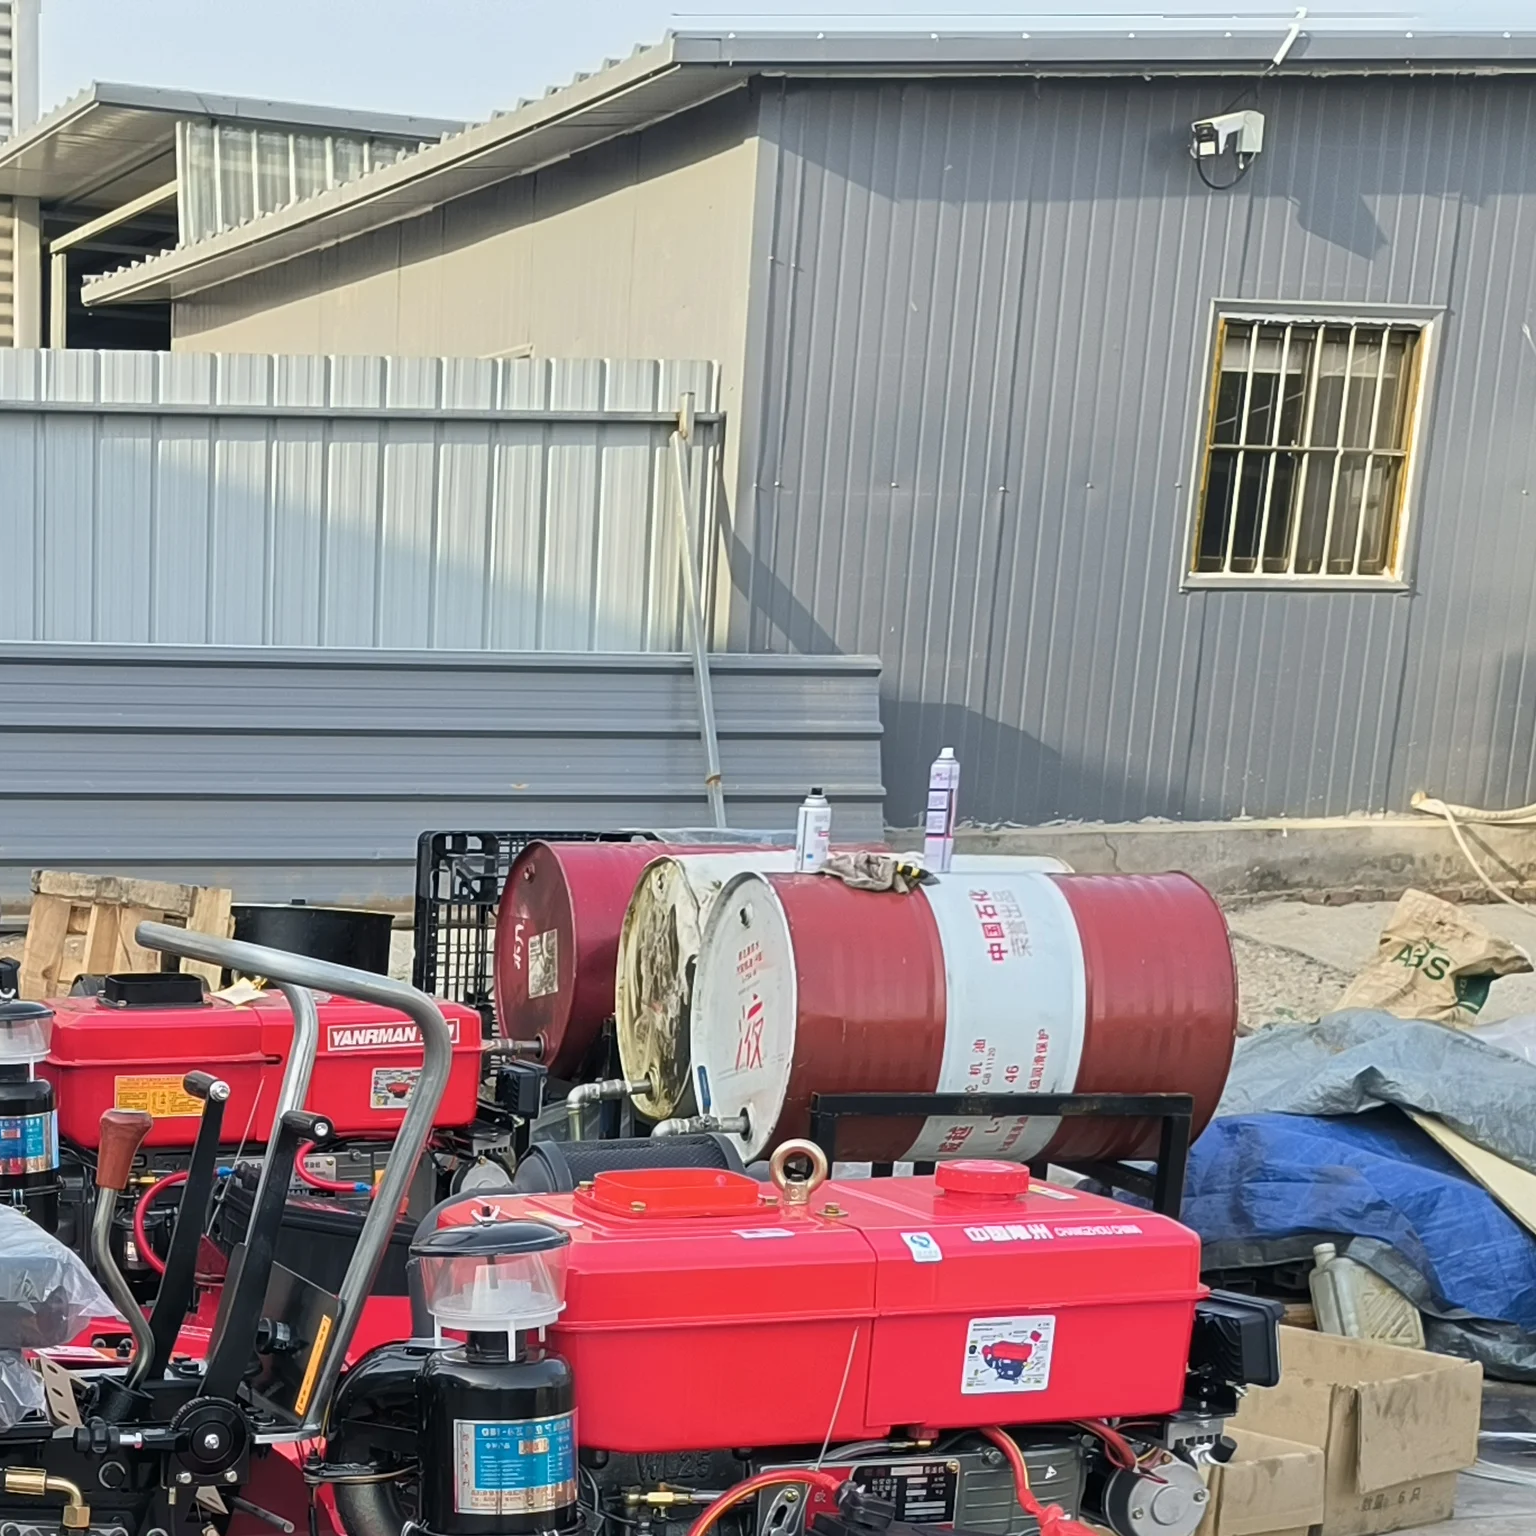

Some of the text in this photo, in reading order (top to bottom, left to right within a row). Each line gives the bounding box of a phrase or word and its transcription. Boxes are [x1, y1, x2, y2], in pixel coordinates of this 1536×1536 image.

[969, 889, 1009, 962] 中国石化
[1391, 943, 1450, 981] ABS
[332, 1026, 417, 1046] YANRMAN
[1004, 1065, 1019, 1083] 46
[964, 1223, 1054, 1242] 中国常州
